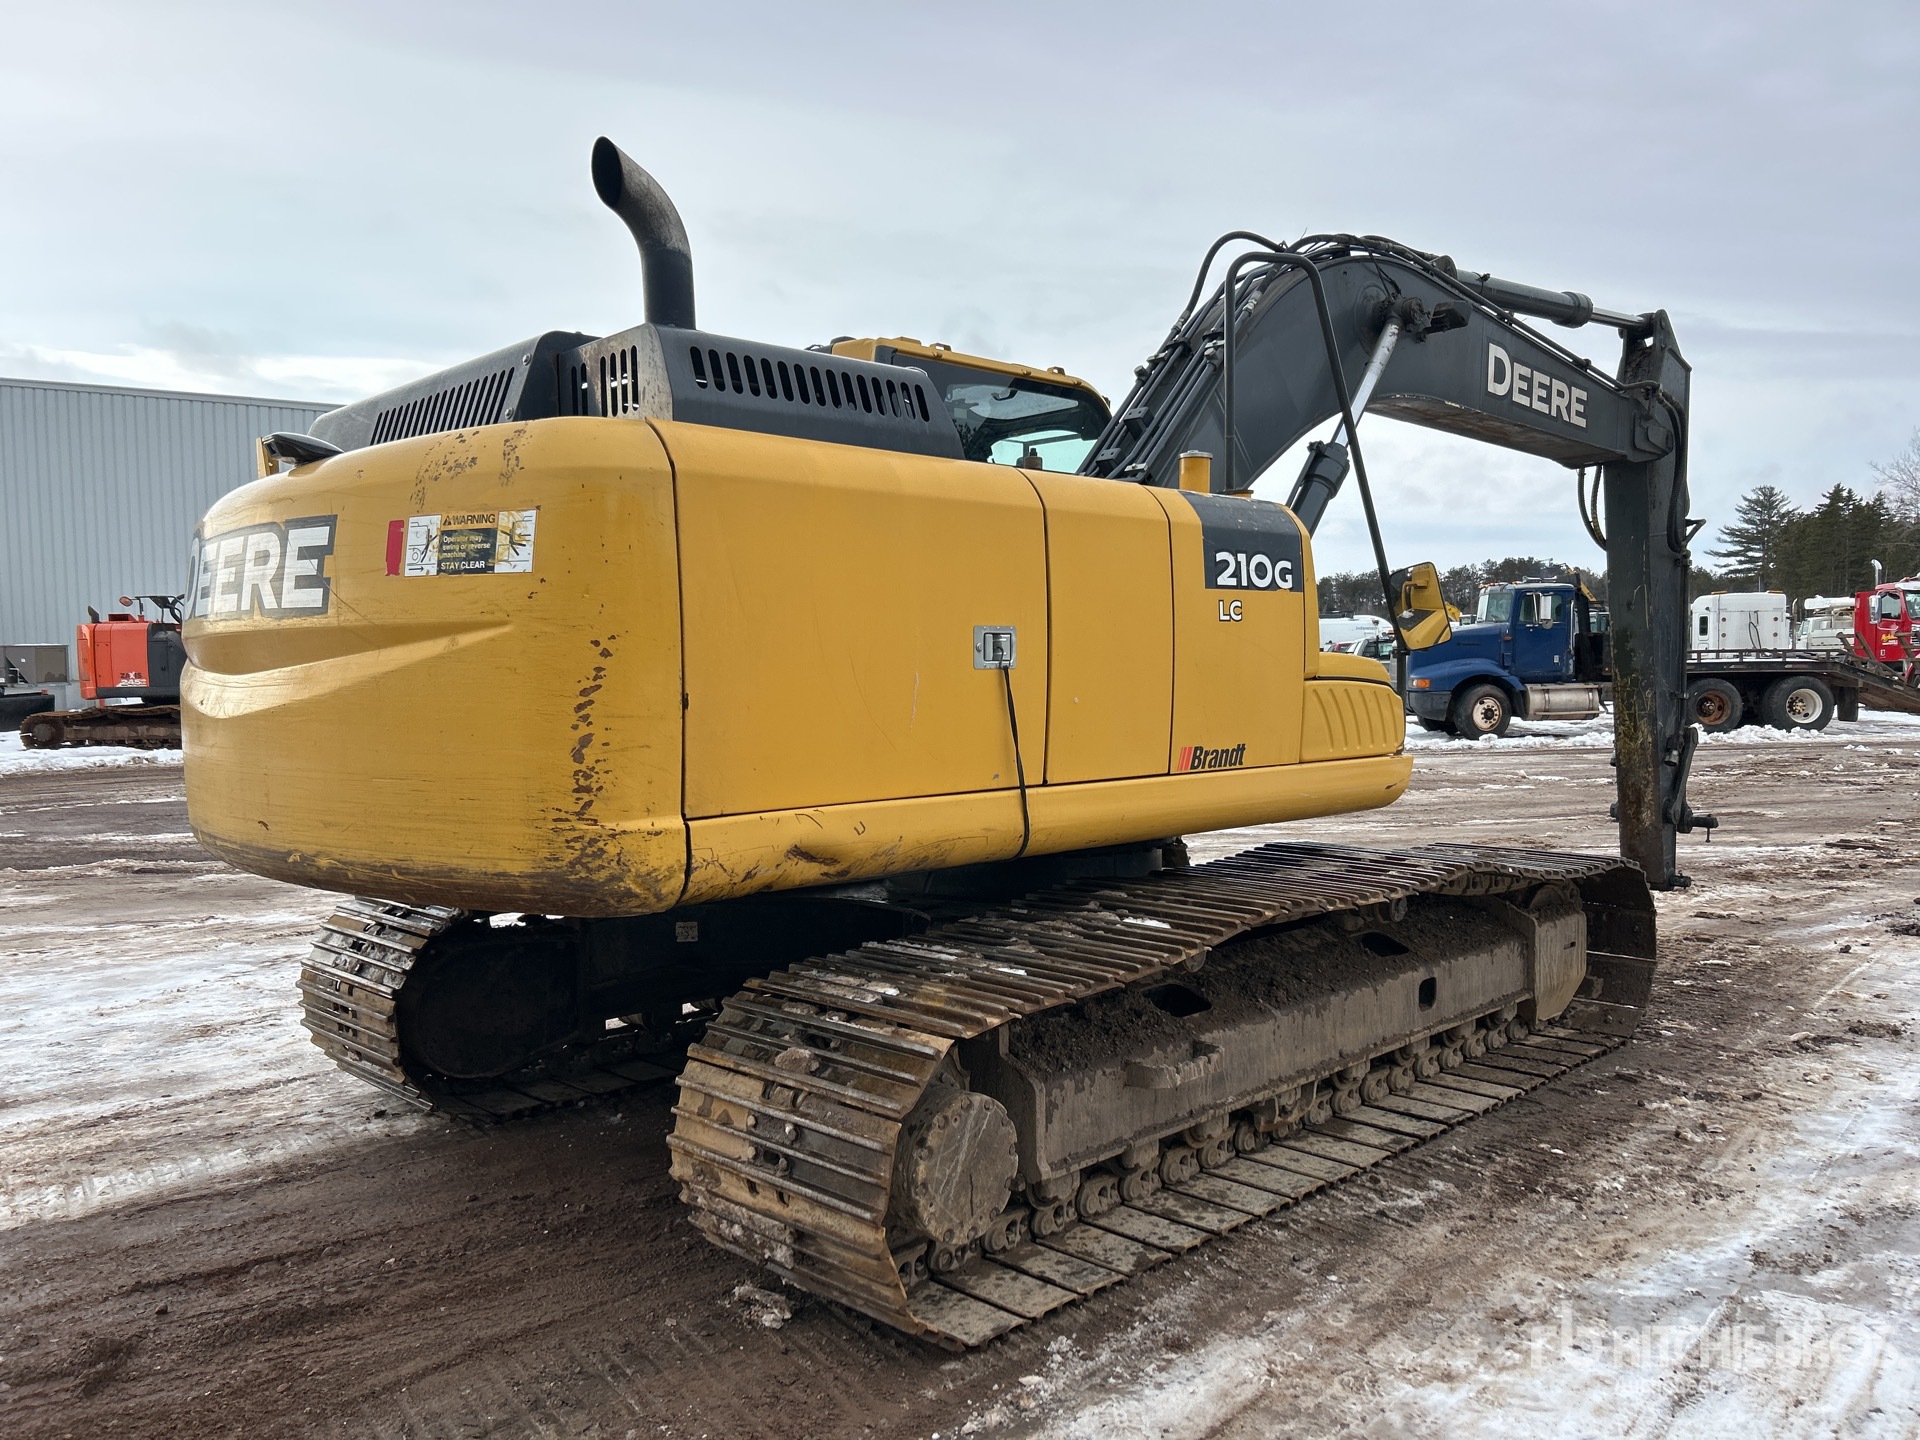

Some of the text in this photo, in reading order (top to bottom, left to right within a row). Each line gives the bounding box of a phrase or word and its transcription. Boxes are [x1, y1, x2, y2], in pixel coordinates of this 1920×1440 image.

[1487, 342, 1588, 428] DEERE
[453, 514, 495, 525] WARNING
[184, 526, 331, 621] DEERE
[441, 561, 485, 570] STAY CLEAR
[1215, 551, 1293, 589] 210G
[1218, 600, 1243, 621] LC
[1190, 744, 1246, 770] Brandt
